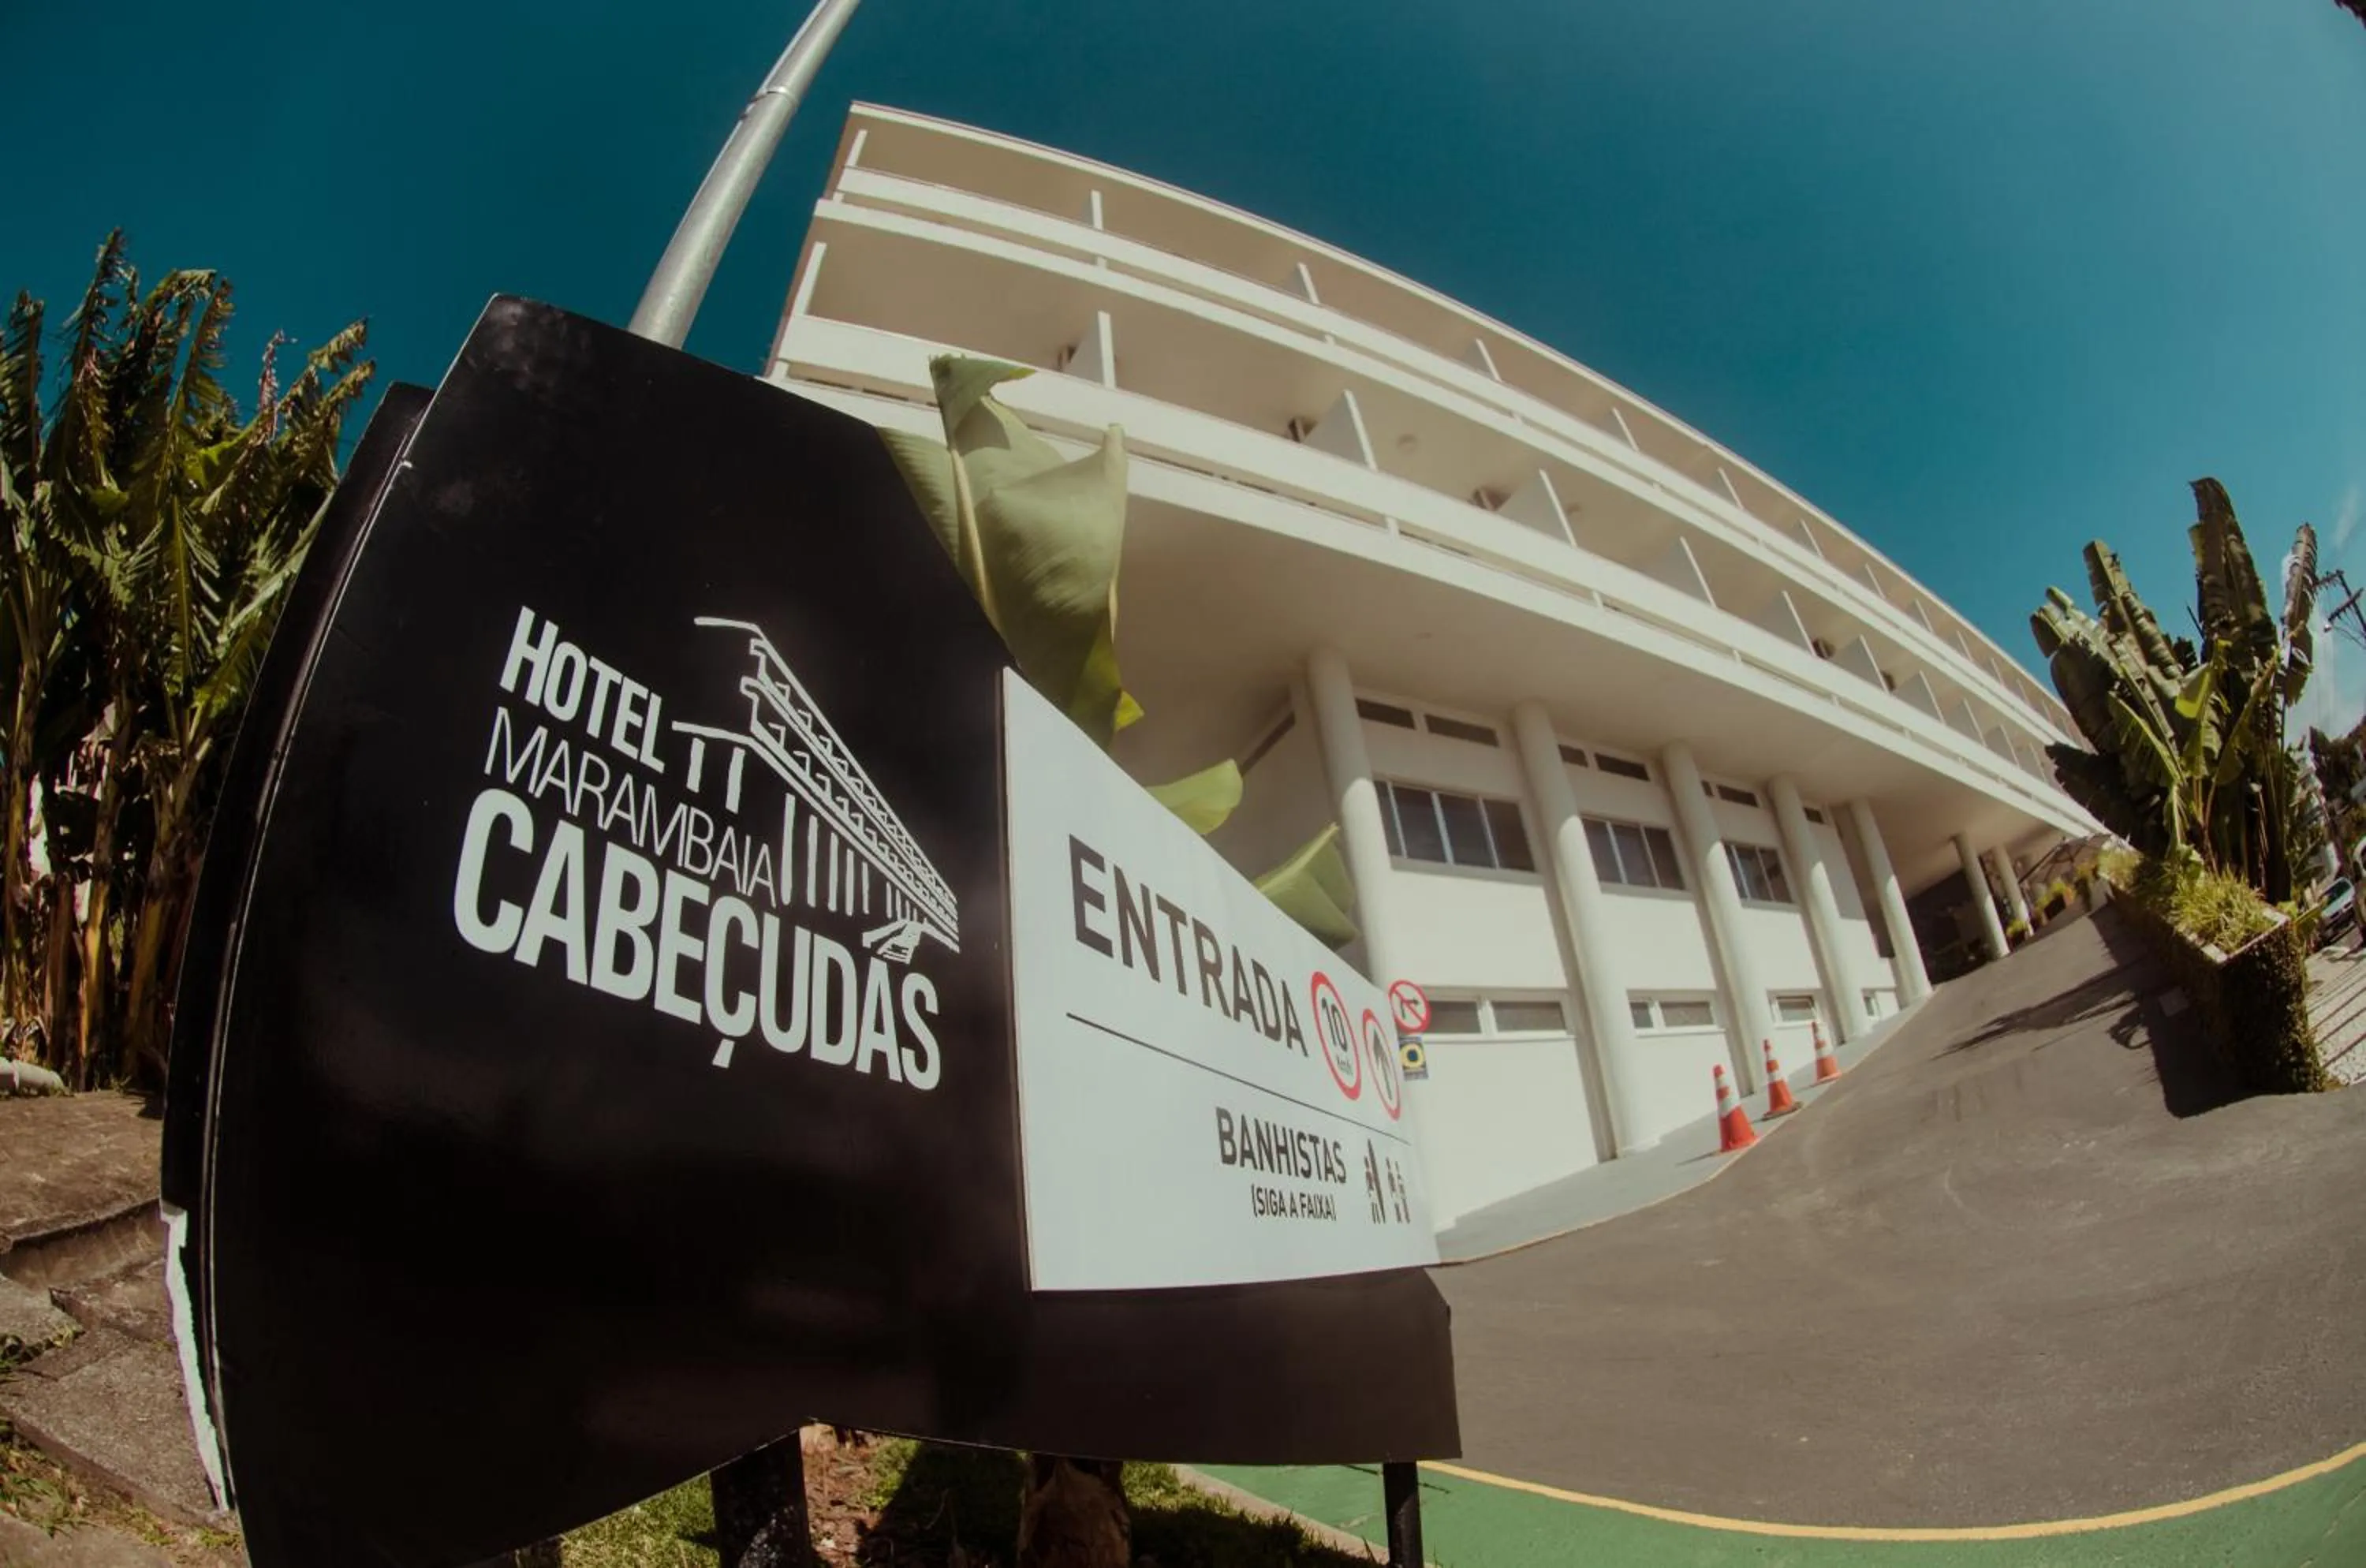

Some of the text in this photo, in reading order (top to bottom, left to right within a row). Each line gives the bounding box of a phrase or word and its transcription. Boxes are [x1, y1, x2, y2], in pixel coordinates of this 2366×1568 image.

[499, 606, 665, 773] HOTEL
[484, 707, 776, 908] MARAMBAIA
[454, 788, 941, 1091] CABEÇUDAS
[1069, 834, 1309, 1057] ENTRADA
[1321, 997, 1348, 1052] 10
[1216, 1107, 1346, 1184] BANHISTAS
[1251, 1183, 1287, 1218] (SIGA
[1289, 1192, 1299, 1219] A
